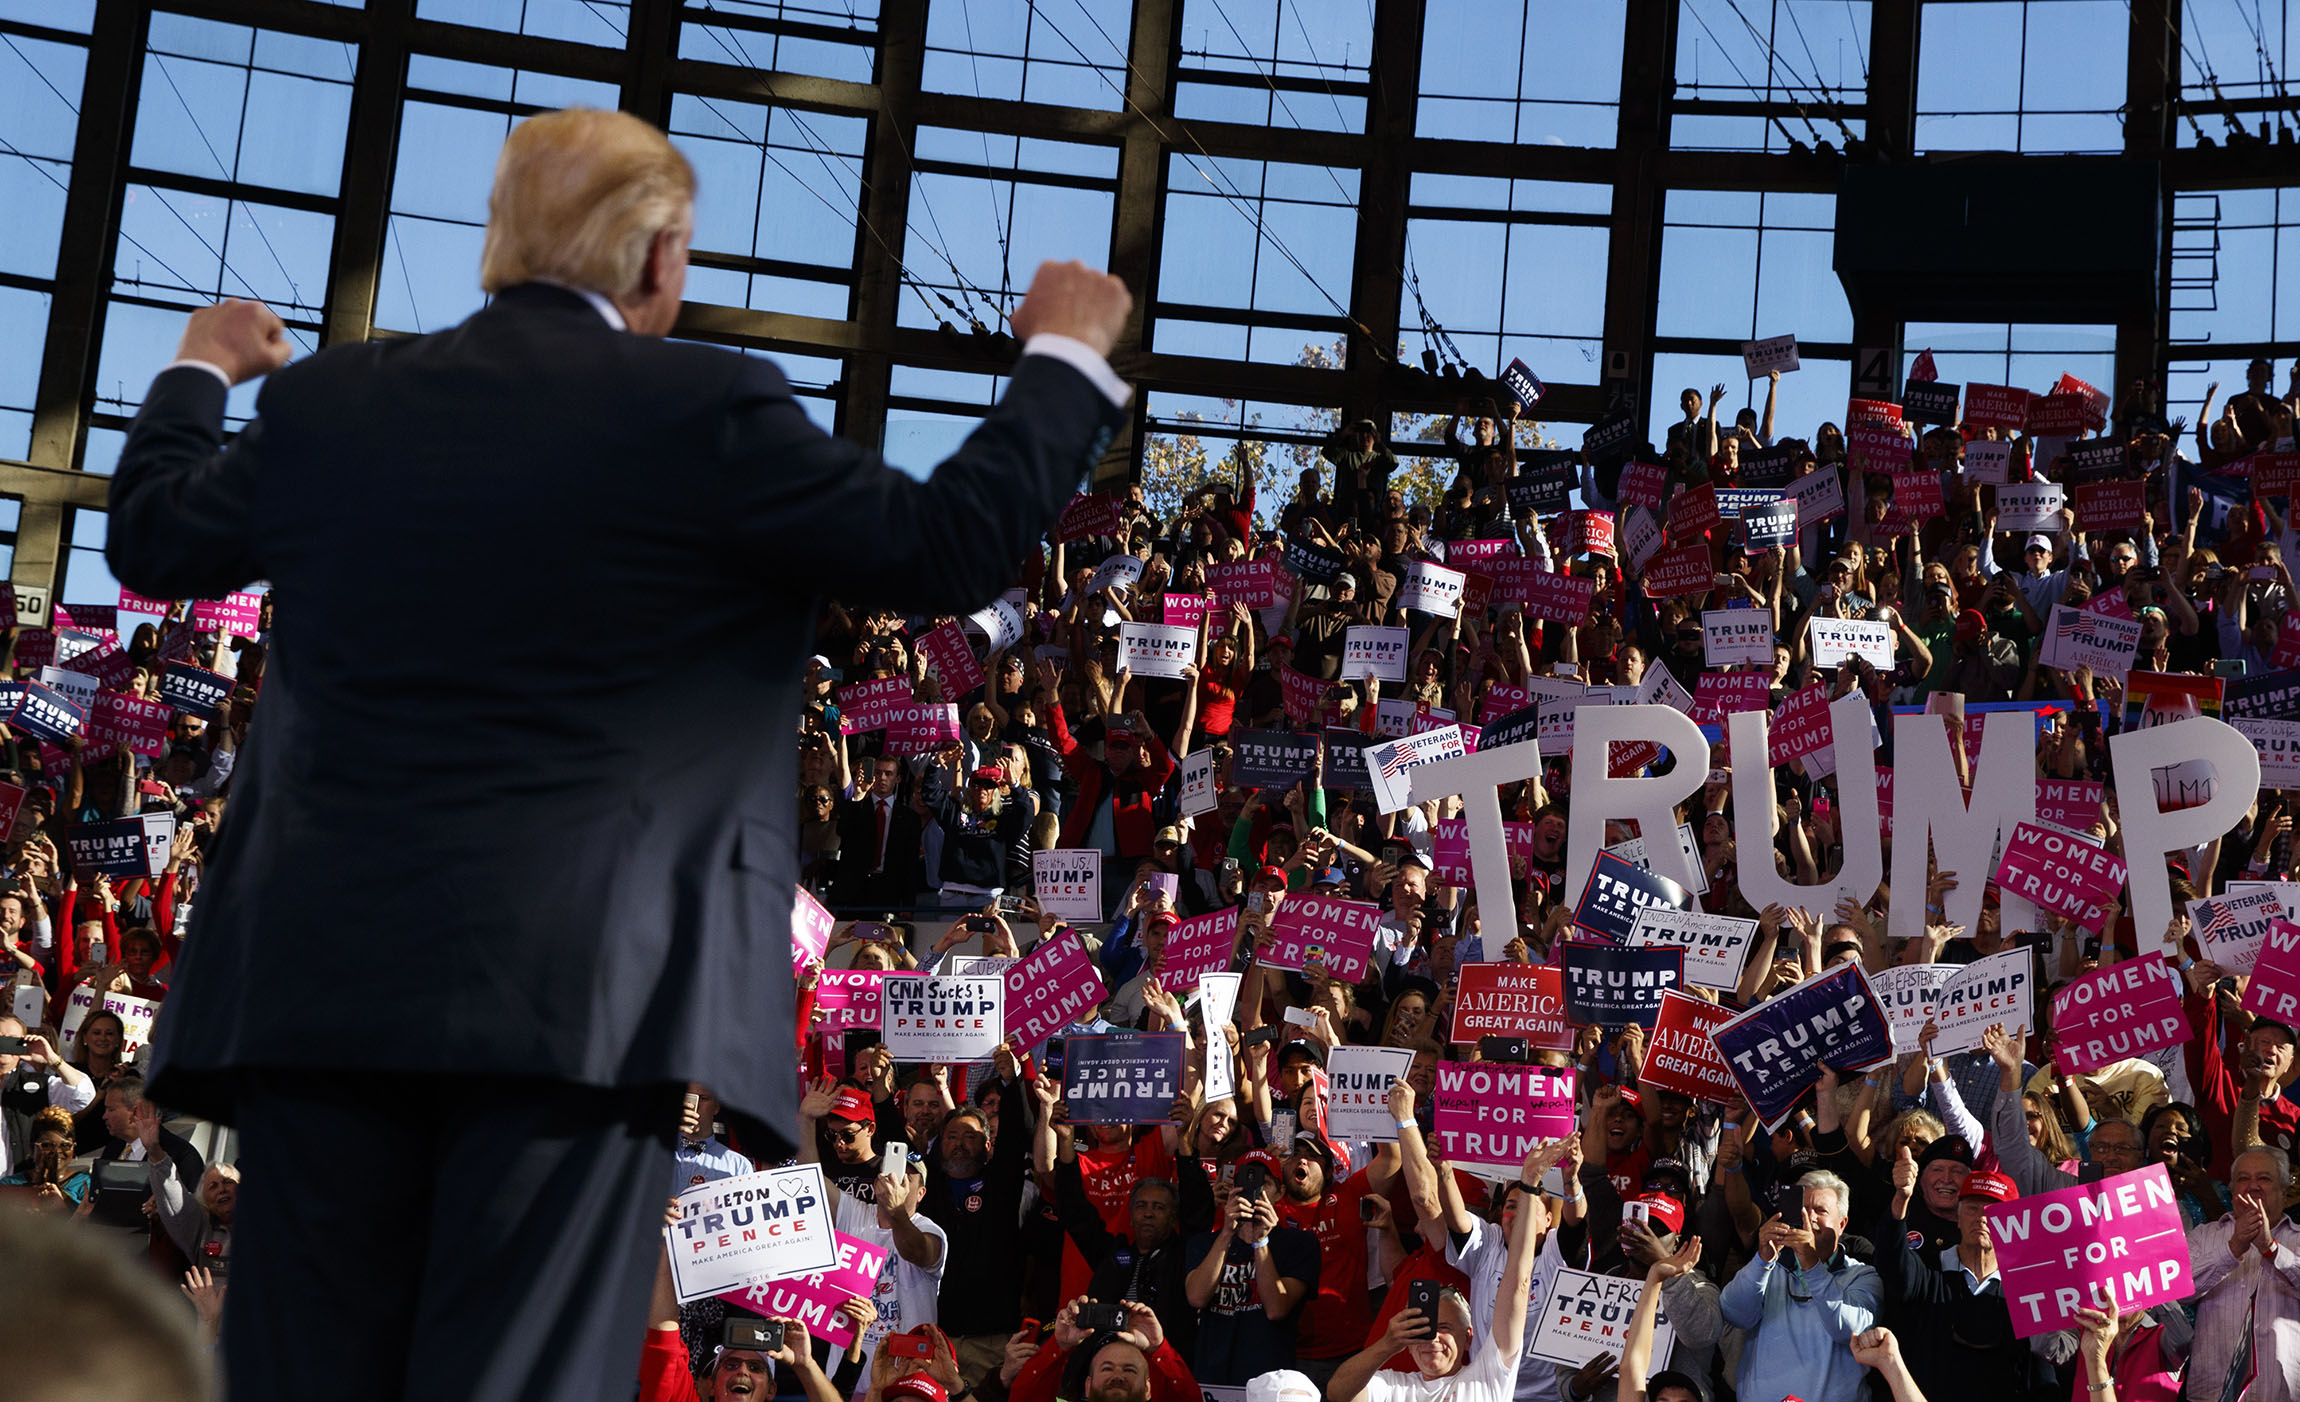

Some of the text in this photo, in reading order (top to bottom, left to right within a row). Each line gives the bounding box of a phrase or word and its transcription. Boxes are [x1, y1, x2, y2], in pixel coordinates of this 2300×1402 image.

[1859, 351, 1892, 391] 4
[1508, 366, 1540, 402] TRUMP
[1906, 390, 1955, 404] TRUMP
[1867, 405, 1888, 414] MAKE
[1965, 397, 2025, 415] AMERICA
[1968, 410, 2021, 422] GREAT AGAIN
[1585, 417, 1631, 442] TRUMP
[1852, 430, 1913, 451] WOMEN
[1965, 452, 2005, 462] TRUMP
[2071, 446, 2124, 461] TRUMP
[1509, 480, 1565, 498] TRUMP
[1893, 473, 1941, 488] WOMEN
[1715, 494, 1782, 503] TRUMP
[1904, 490, 1922, 500] FOR
[1999, 496, 2058, 506] TRUMP
[2004, 505, 2052, 514] PENCE
[2078, 496, 2143, 514] AMERICA
[1745, 513, 1796, 527] TRUMP
[2081, 510, 2140, 523] GREAT AGAIN
[1751, 523, 1794, 535] PENCE
[1288, 543, 1341, 570] TRUMP
[1450, 541, 1516, 556] WOMEN
[1663, 554, 1687, 565] MAKE
[1205, 562, 1271, 579] WOMEN
[1646, 562, 1711, 581] AMERICA
[1226, 580, 1250, 589] FOR
[1406, 575, 1458, 592] TRUMP
[1535, 573, 1592, 594] WOMEN
[1650, 574, 1708, 591] GREAT AGAIN
[15, 594, 41, 614] 50
[1552, 594, 1576, 606] FOR
[215, 607, 239, 617] FOR
[1531, 603, 1585, 623] TRUMP
[195, 616, 255, 634] TRUMP
[1708, 623, 1769, 637] TRUMP
[1833, 622, 1867, 633] SOUTH
[2092, 618, 2139, 635] VETERANS
[1125, 636, 1191, 651] TRUMP
[1348, 640, 1403, 652] TRUMP
[1715, 634, 1765, 645] PENCE
[1817, 632, 1886, 643] TRUMP
[1825, 642, 1880, 650] PENCE
[2071, 631, 2136, 654] TRUMP
[2118, 632, 2136, 643] FOR
[1129, 648, 1184, 659] PENCE
[1348, 652, 1396, 661] PENCE
[165, 672, 226, 699] TRUMP
[839, 676, 910, 701] WOMEN
[1699, 675, 1770, 690] WOMEN
[164, 683, 217, 704] PENCE
[1717, 694, 1742, 704] FOR
[25, 693, 80, 727] TRUMP
[96, 693, 171, 721] WOMEN
[862, 698, 888, 711] FOR
[113, 715, 140, 729] FOR
[888, 708, 959, 722] WOMEN
[910, 727, 937, 736] FOR
[1780, 716, 1806, 734] FOR
[2237, 721, 2299, 738] Police Wife
[92, 724, 159, 750] TRUMP
[1409, 730, 1458, 750] VETERANS
[1441, 740, 1460, 751] FOR
[1769, 725, 1831, 764] TRUMP
[1239, 743, 1315, 760] TRUMP
[1244, 757, 1307, 769] PENCE
[69, 834, 141, 851] TRUMP
[76, 848, 135, 861] PENCE
[1071, 855, 1093, 870] US!
[2016, 826, 2128, 886] WOMEN
[1036, 870, 1094, 884] TRUMP
[2042, 859, 2084, 887] FOR
[1038, 885, 1086, 894] PENCE
[2006, 864, 2102, 922] TRUMP
[2224, 891, 2277, 912] VETERANS
[2259, 902, 2282, 916] FOR
[1281, 899, 1380, 932] WOMEN
[1592, 903, 1633, 925] MAKE AMERICA
[1167, 911, 1239, 946] WOMEN
[1300, 925, 1337, 944] FOR
[1641, 925, 1743, 948] TRUMP
[1183, 944, 1212, 961] FOR
[1159, 958, 1228, 988] TRUMP
[1568, 966, 1677, 988] TRUMP
[888, 980, 973, 1000] CNN Sucks
[1497, 976, 1538, 990] MAKE
[1939, 973, 2025, 1010] TRUMP
[2053, 958, 2170, 1017] WOMEN
[1023, 977, 1060, 1009] FOR
[1576, 986, 1663, 1001] PENCE
[890, 1000, 995, 1016] TRUMP
[1574, 999, 1591, 1007] MAKE
[1591, 1001, 1620, 1009] AMERICA
[1941, 994, 2016, 1021] PENCE
[1011, 980, 1097, 1048] TRUMP
[1956, 1016, 1980, 1028] AMERICA
[2088, 1002, 2136, 1029] FOR
[897, 1018, 984, 1029] PENCE
[1464, 1015, 1564, 1034] GREAT AGAIN
[1732, 993, 1867, 1074] TRUMP
[2062, 1016, 2180, 1067] TRUMP
[1758, 1019, 1864, 1086] PENCE
[1079, 1067, 1166, 1080] PENCE
[1655, 1054, 1737, 1089] GREAT AGAIN
[1762, 1034, 1874, 1097] MAKE AGAIN!
[1328, 1072, 1397, 1090] TRUMP
[1439, 1069, 1574, 1099] WOMEN
[1067, 1081, 1174, 1099] TRUMP
[1331, 1092, 1390, 1105] PENCE
[1478, 1105, 1526, 1124] FOR
[1245, 1150, 1273, 1161] TRUMP
[838, 1175, 859, 1185] VOTE
[1984, 1178, 2009, 1191] AMERICA
[1987, 1187, 2006, 1196] AGAIN
[677, 1195, 816, 1240] TRUMP
[1989, 1173, 2175, 1245] WOMEN
[692, 1219, 807, 1254] PENCE
[691, 1235, 813, 1267] MAKE AMERICA GREAT AGAIN!
[2062, 1236, 2129, 1270] FOR
[745, 1273, 770, 1283] 2016
[2019, 1259, 2181, 1323] TRUMP
[1552, 1328, 1605, 1345] MAKE AMERICA
